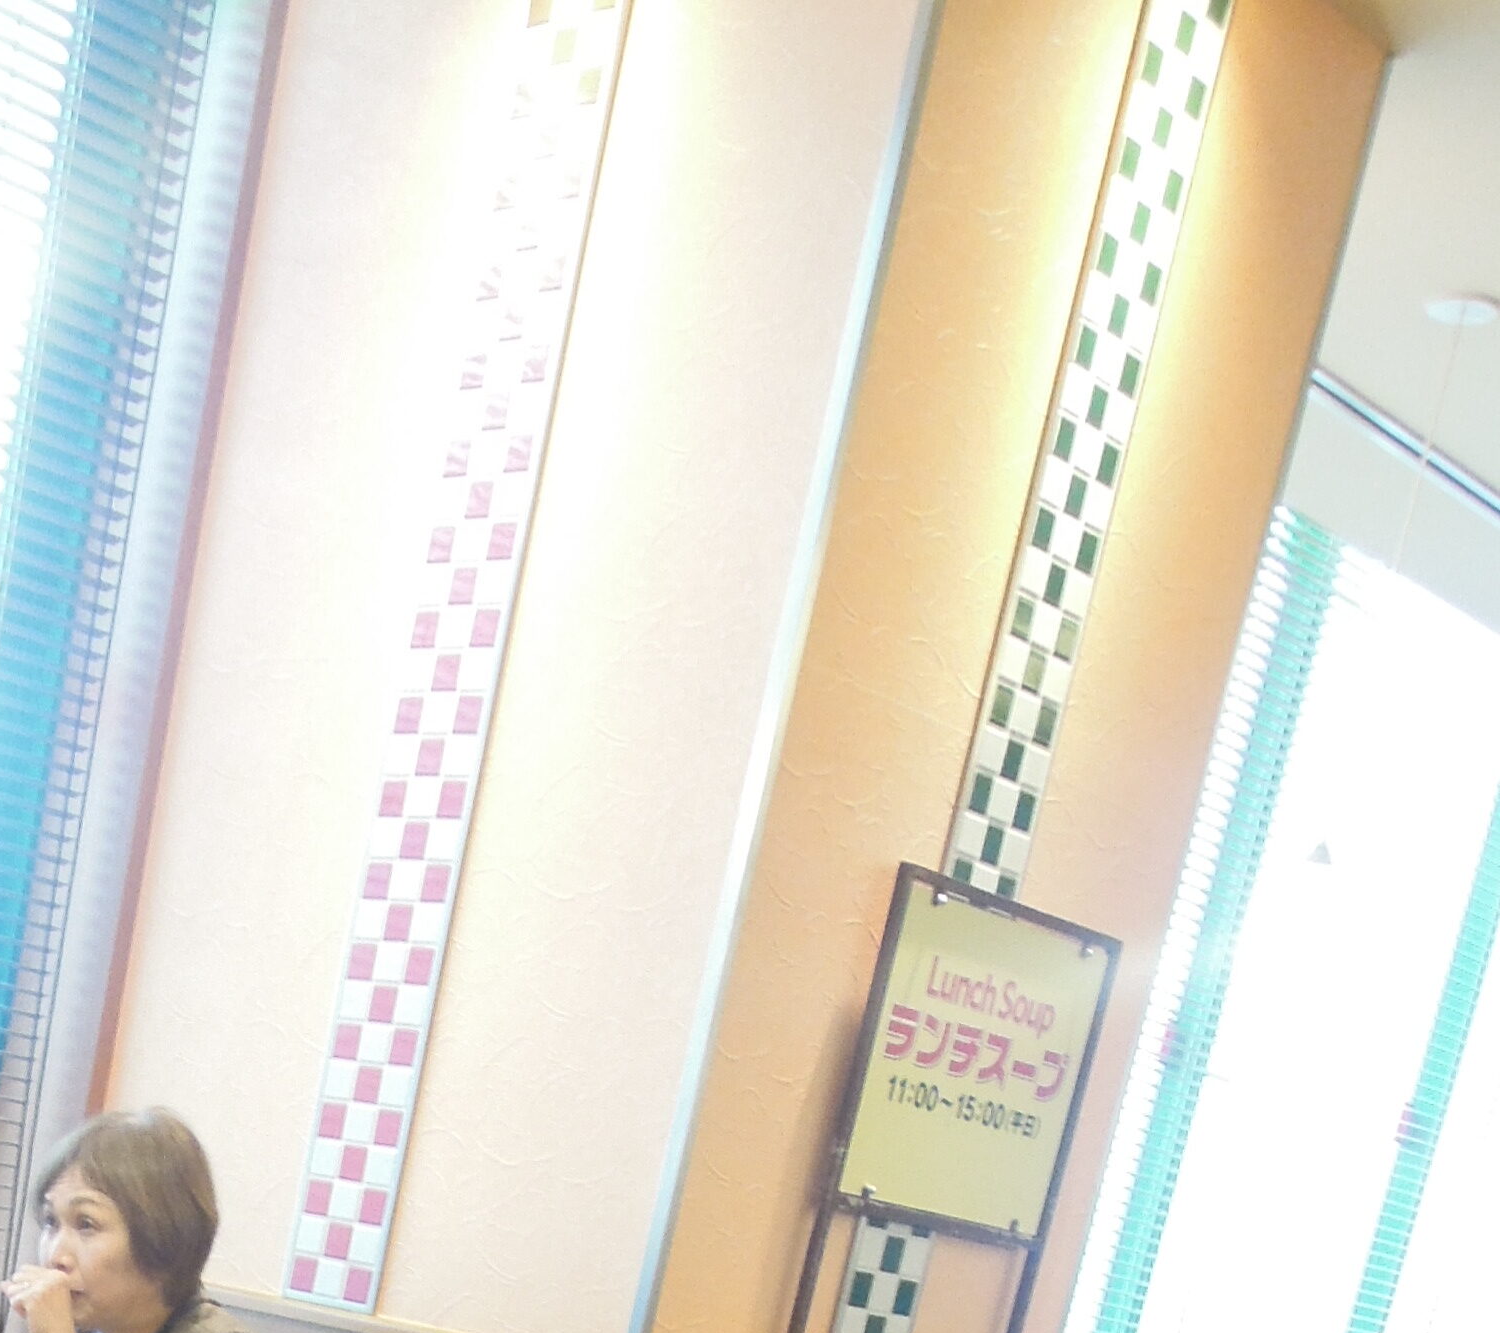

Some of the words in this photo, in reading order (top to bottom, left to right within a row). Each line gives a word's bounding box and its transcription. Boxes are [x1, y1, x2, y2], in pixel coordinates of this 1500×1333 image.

[927, 955, 997, 1016] Lunch
[998, 981, 1056, 1040] Soup
[884, 1003, 1070, 1101] ランチスープ
